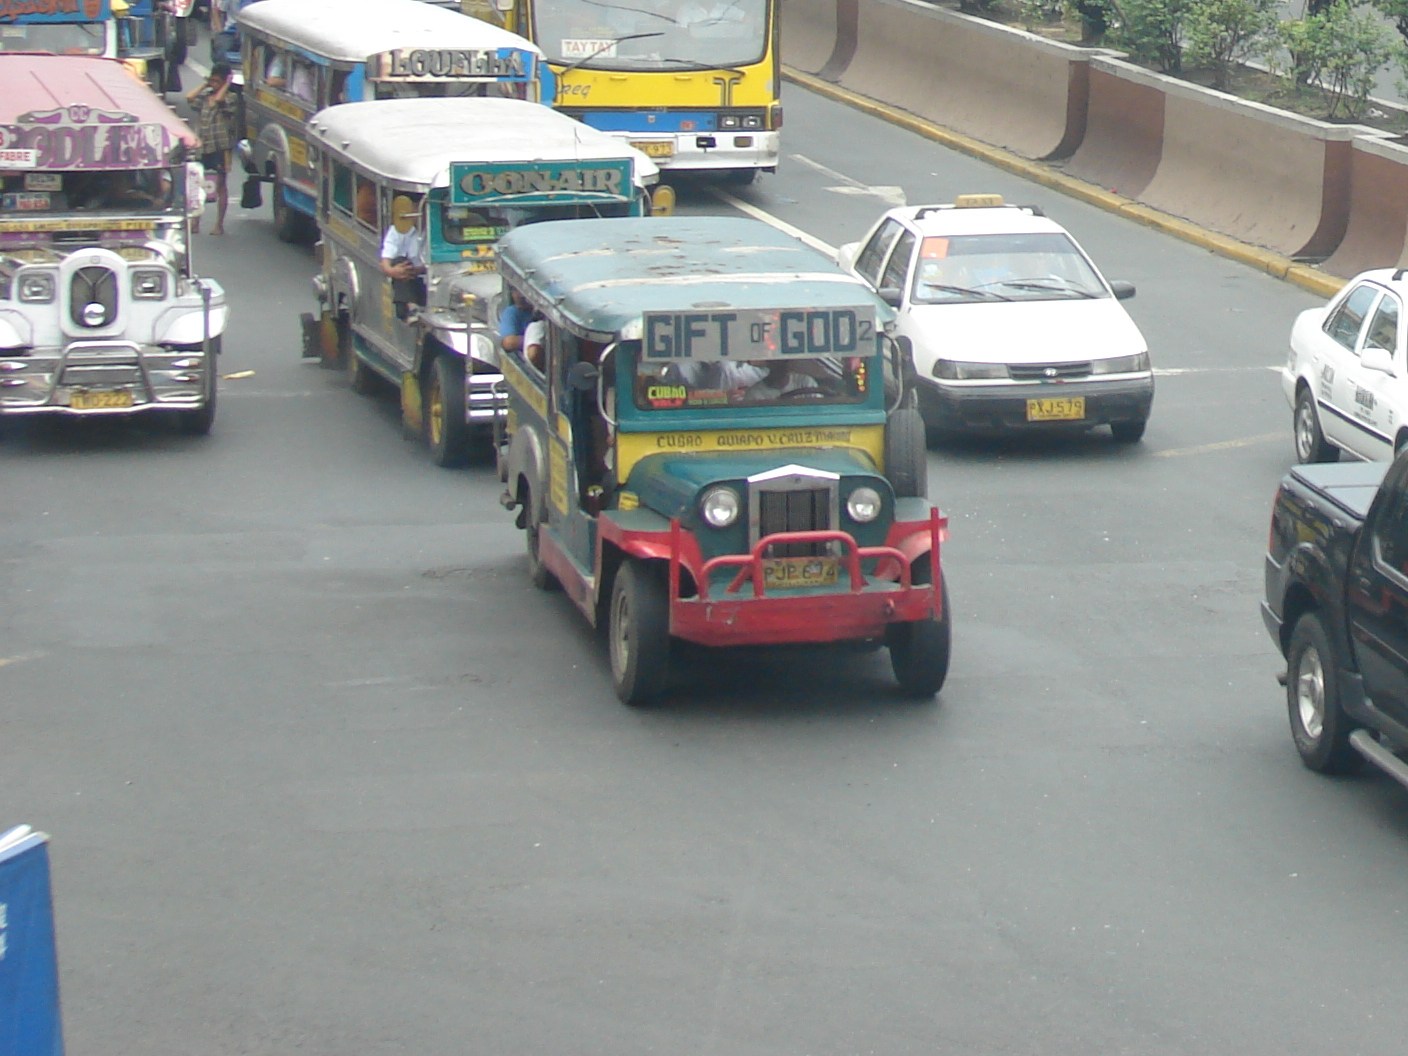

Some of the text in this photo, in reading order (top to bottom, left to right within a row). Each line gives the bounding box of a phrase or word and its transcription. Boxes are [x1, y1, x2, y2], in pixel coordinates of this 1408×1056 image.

[646, 310, 873, 358] GIFT OF GOD 2
[657, 434, 702, 448] CUBAO
[717, 433, 764, 447] QUIAPO
[779, 431, 814, 445] CRUZ
